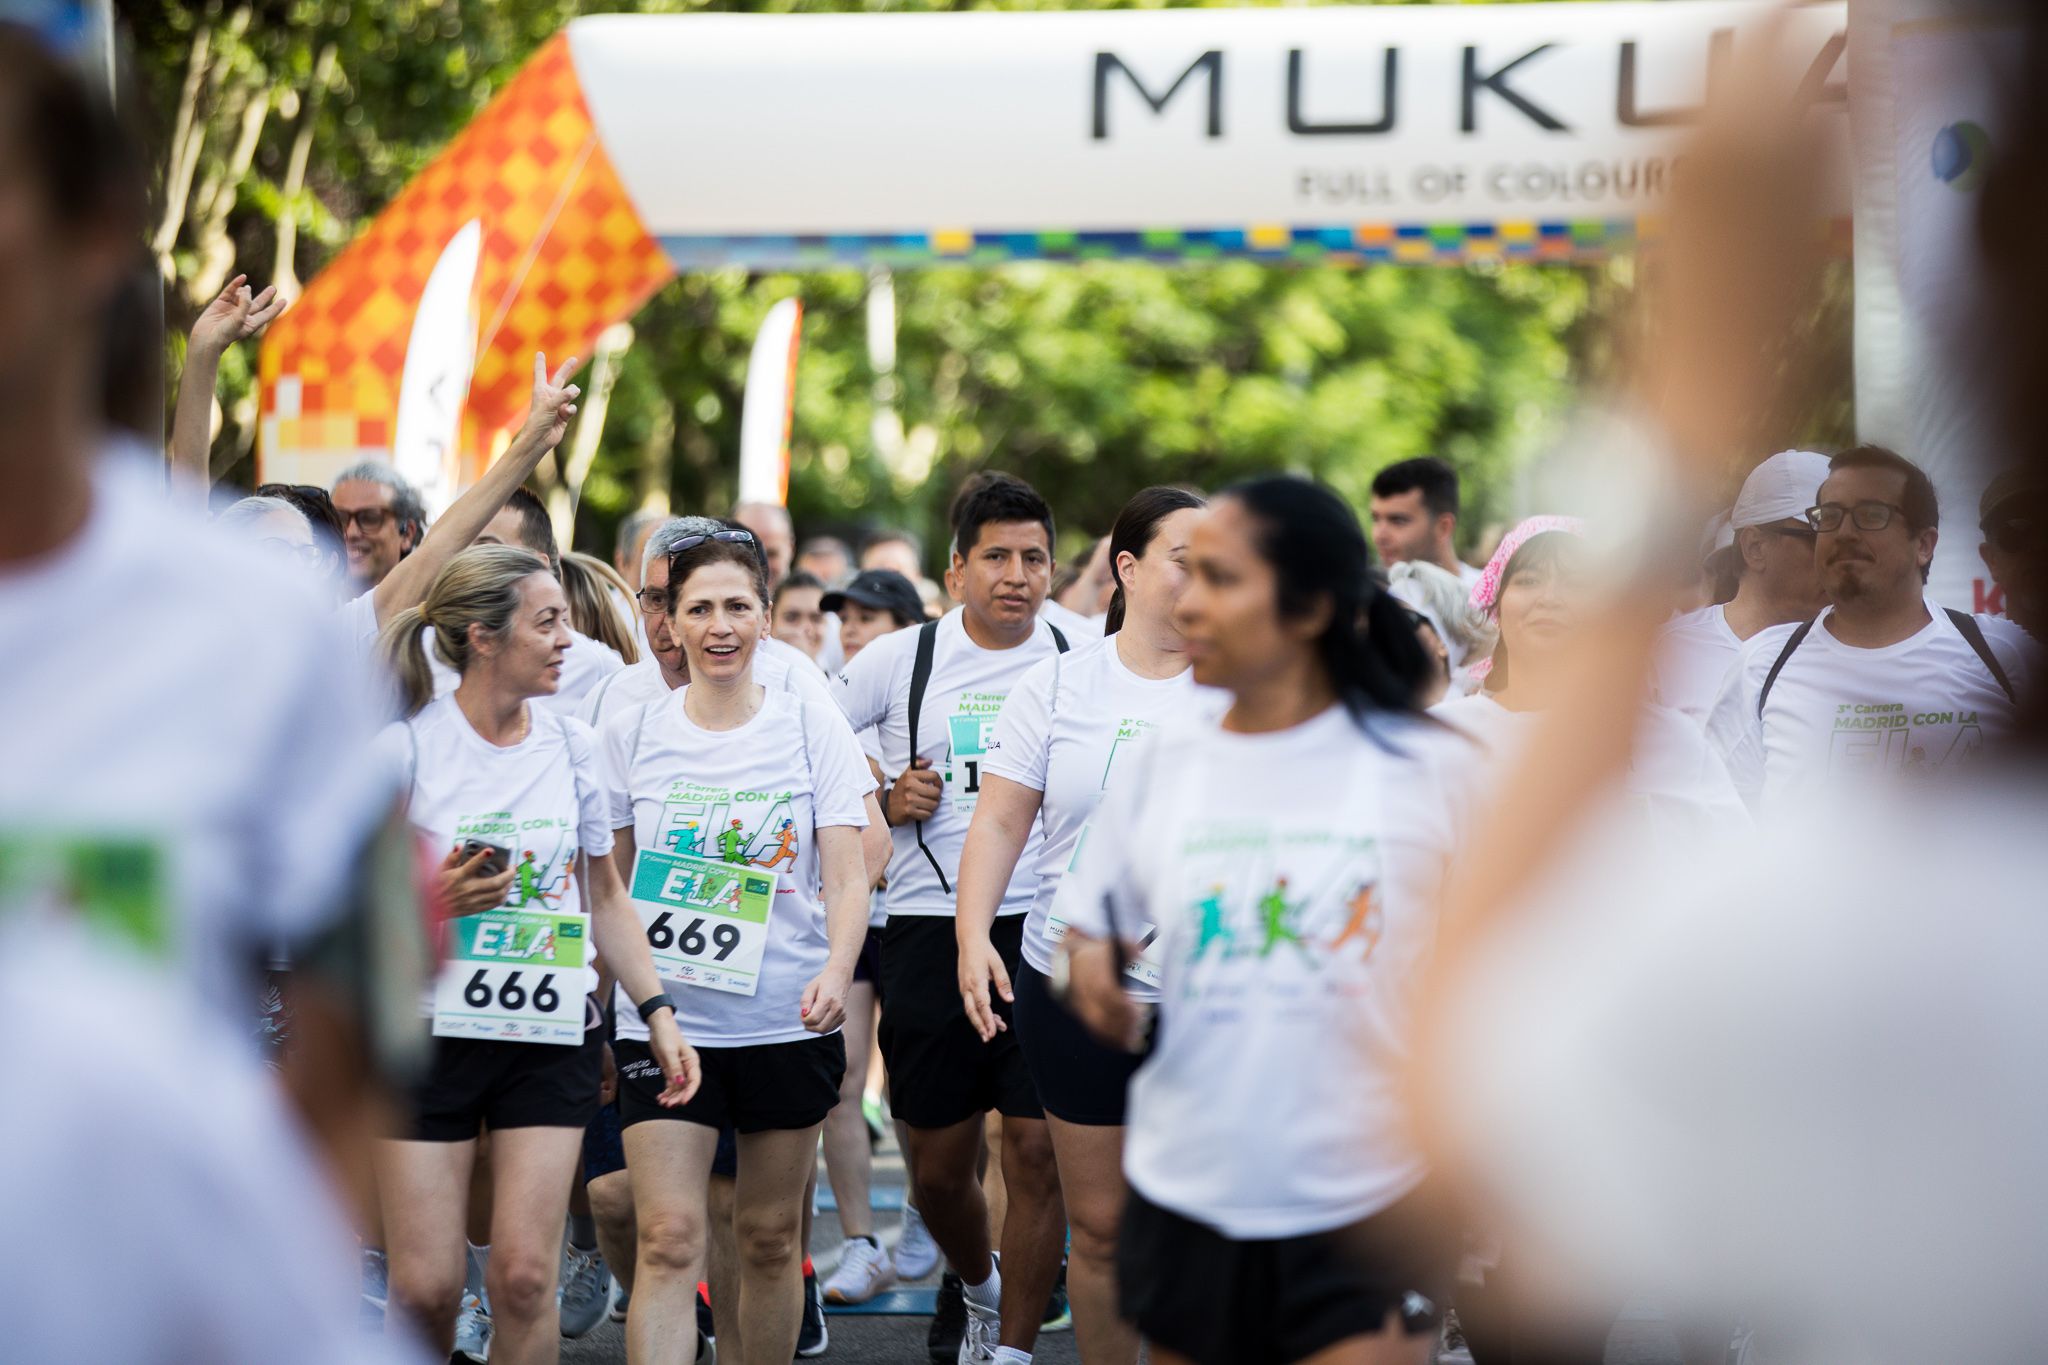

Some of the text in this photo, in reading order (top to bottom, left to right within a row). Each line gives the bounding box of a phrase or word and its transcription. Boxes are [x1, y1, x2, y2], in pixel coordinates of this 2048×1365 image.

[1297, 171, 1396, 202] FULL
[1412, 168, 1467, 202] OF
[973, 692, 1008, 702] Carrer
[958, 703, 1001, 712] MADR
[1854, 703, 1904, 714] Carrera
[1834, 711, 1978, 729] MADRID CON LA
[964, 761, 980, 793] 1
[667, 791, 792, 802] MADRID CON LA
[457, 822, 516, 835] MADRID
[522, 819, 552, 830] CON
[672, 860, 707, 872] MADRID
[659, 867, 741, 914] ELA
[470, 921, 556, 961] ELA
[647, 911, 740, 962] 669
[464, 968, 560, 1013] 666
